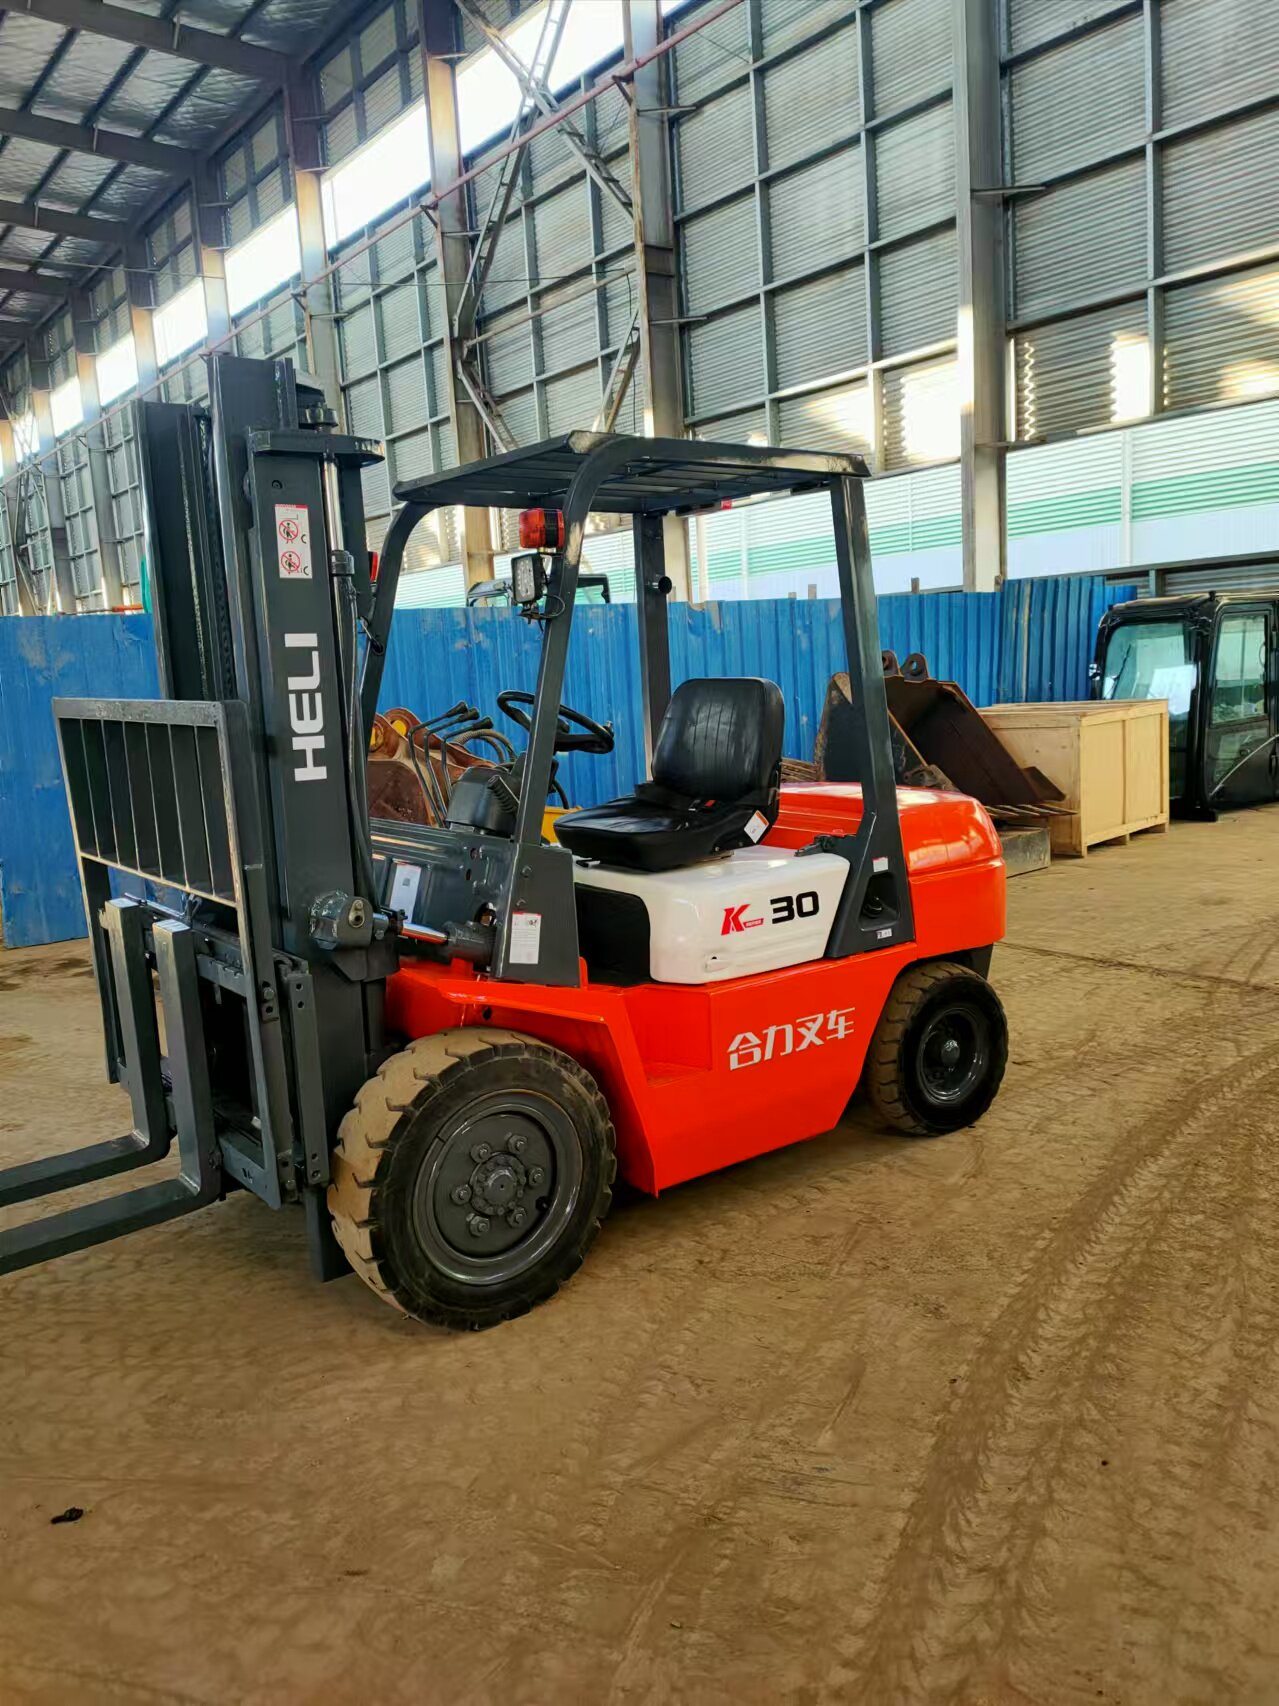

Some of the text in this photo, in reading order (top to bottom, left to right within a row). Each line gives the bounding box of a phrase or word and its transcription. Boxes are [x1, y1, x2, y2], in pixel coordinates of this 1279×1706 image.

[284, 633, 327, 782] HELI
[721, 891, 819, 936] K 30
[727, 1007, 855, 1071] 合力叉车
